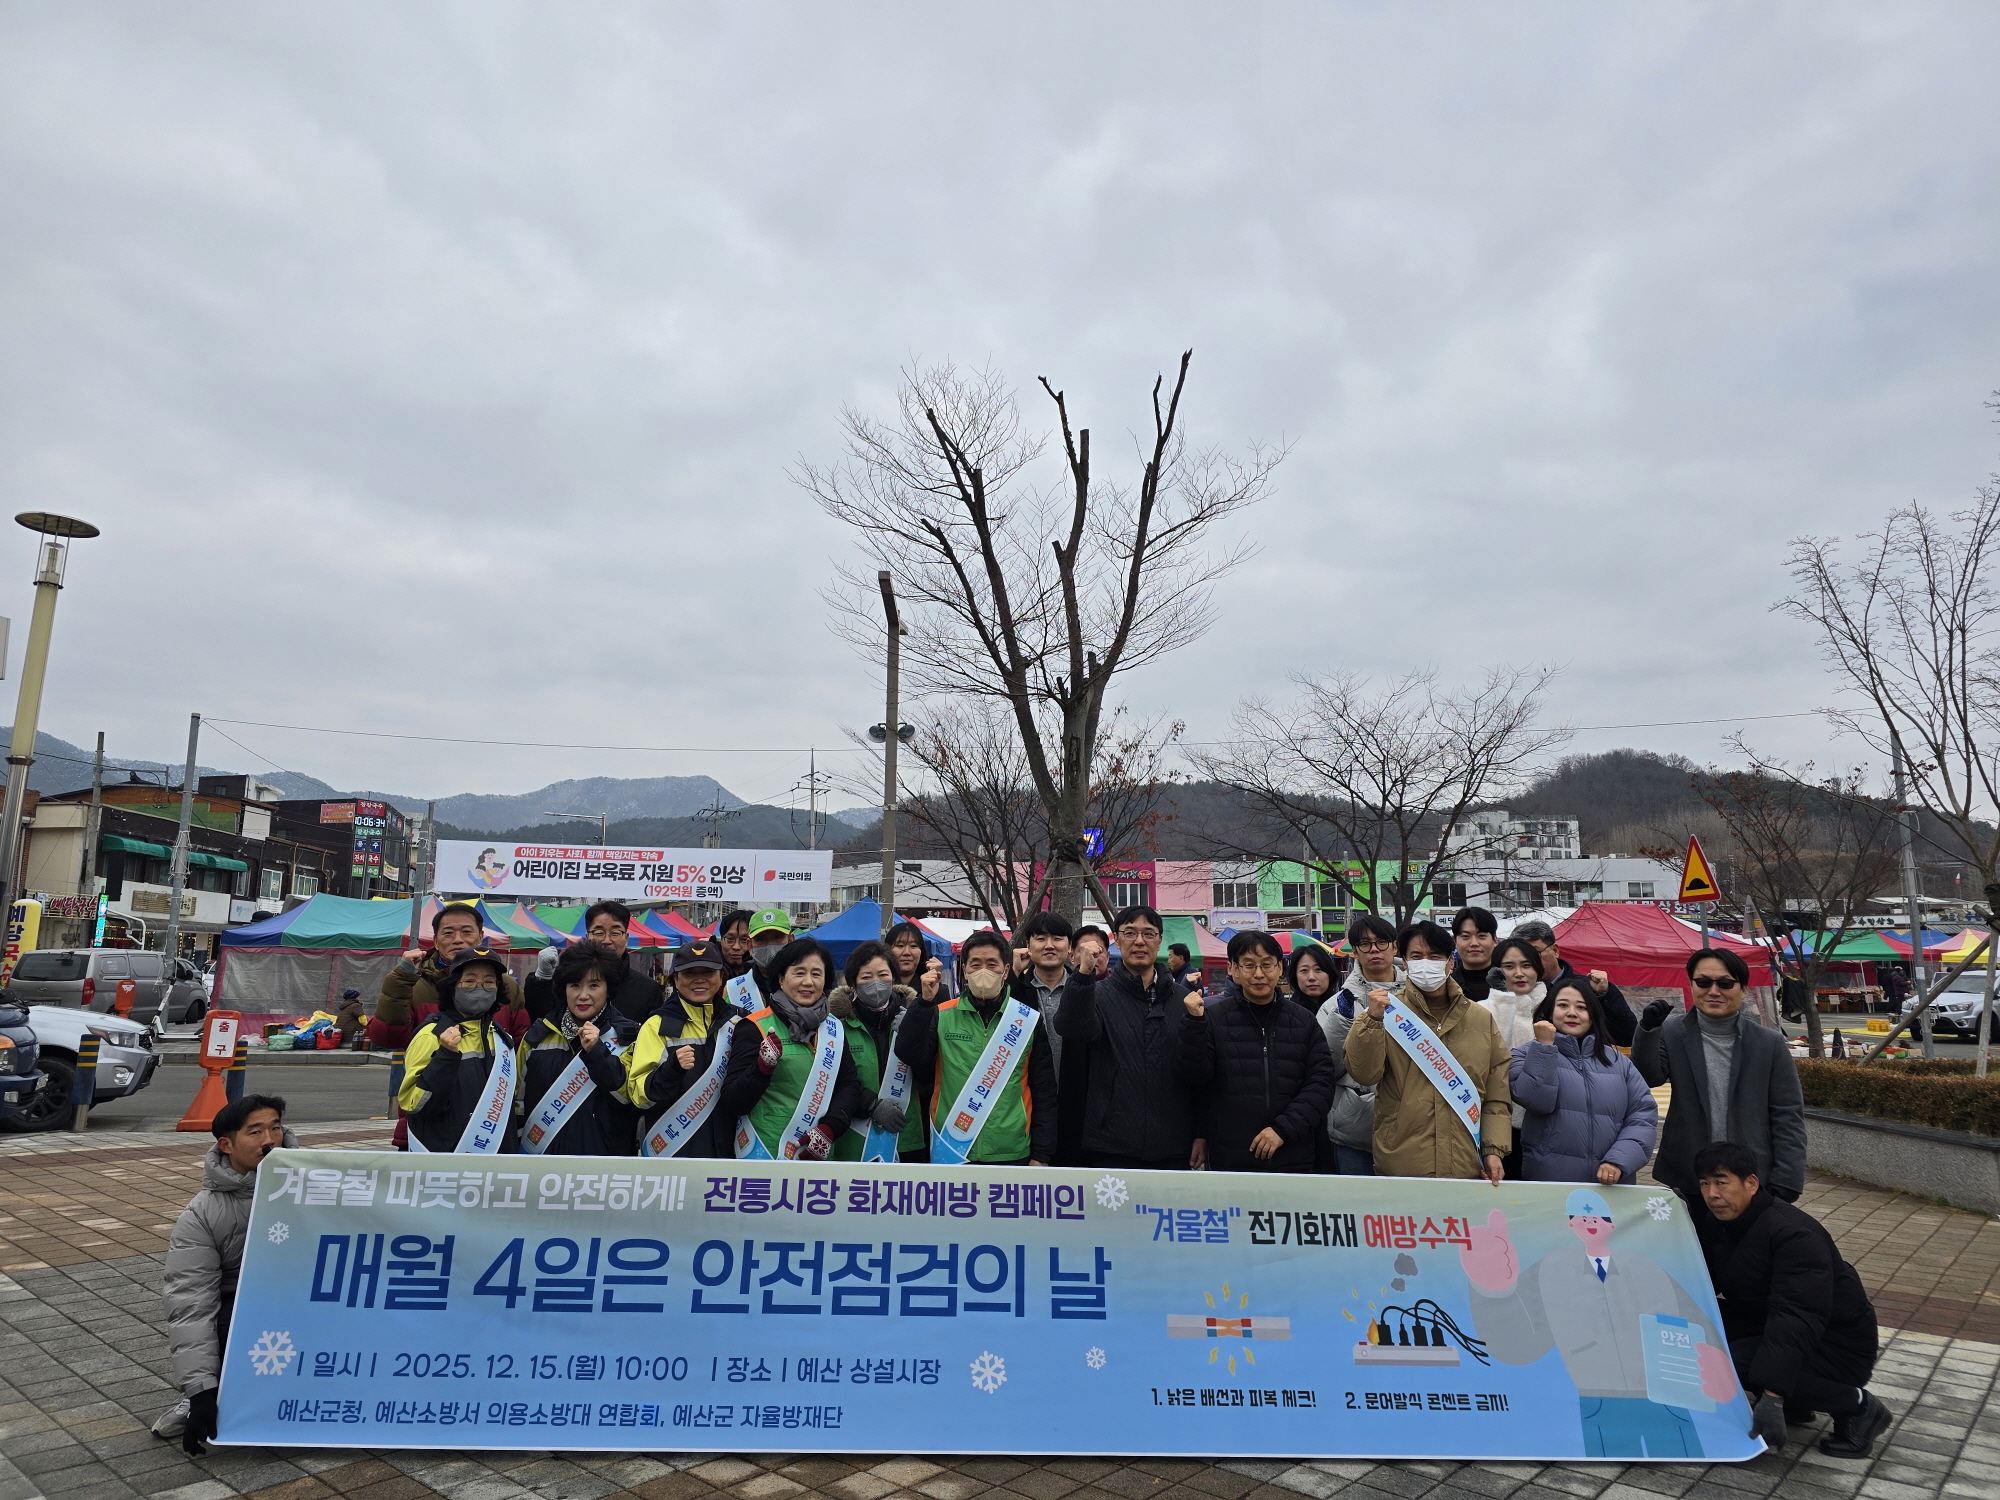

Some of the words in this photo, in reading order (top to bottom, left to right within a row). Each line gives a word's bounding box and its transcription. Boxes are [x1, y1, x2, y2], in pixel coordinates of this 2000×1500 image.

[354, 816, 386, 828] 10:06:34
[521, 848, 538, 857] 아이
[539, 848, 564, 858] 키우는
[566, 849, 585, 859] 사회,
[586, 850, 604, 859] 함께
[606, 851, 640, 860] 책임지는
[641, 852, 658, 861] 약속
[514, 860, 581, 880] 어린이집
[583, 862, 636, 881] 보육료
[638, 864, 674, 882] 지원
[676, 865, 706, 883] 5%
[710, 865, 746, 884] 인상
[778, 872, 812, 882] 국민의힘
[644, 885, 693, 898] (192억원
[696, 886, 724, 898] 증액)
[1004, 1018, 1023, 1047] 4일은
[822, 1040, 836, 1070] 4일은
[1394, 1013, 1422, 1042] 4일은
[1416, 1038, 1464, 1091] 안전점검의
[1456, 1088, 1472, 1104] 날
[974, 1045, 1012, 1100] 안전점검의
[802, 1070, 830, 1126] 안전점검의
[890, 1085, 904, 1098] 날
[480, 1076, 510, 1134] 안전점검의
[676, 1078, 719, 1130] 안전점검의
[968, 1097, 983, 1112] 날
[540, 1110, 556, 1127] 날
[474, 1134, 490, 1150] 날
[664, 1124, 680, 1140] 날
[268, 1167, 379, 1207] 겨울철
[385, 1170, 530, 1210] 따뜻하고
[538, 1173, 687, 1212] 안전하게!
[703, 1176, 840, 1215] 전통시장
[847, 1178, 979, 1218] 화재예방
[988, 1183, 1086, 1220] 캠페인
[1248, 1210, 1358, 1248] 전기화재
[1363, 1214, 1473, 1251] 예방수칙
[310, 1234, 456, 1311] 매월
[473, 1237, 670, 1314] 4일은
[690, 1239, 1026, 1318] 안전점검의
[1049, 1246, 1112, 1320] 날
[1660, 1330, 1691, 1350] 안전
[314, 1351, 360, 1378] 일시
[393, 1352, 476, 1379] 2025.
[486, 1354, 519, 1379] 12.
[615, 1356, 688, 1382] 10:00
[726, 1357, 772, 1384] 장소
[797, 1358, 842, 1384] 예산
[850, 1358, 942, 1385] 상설시장
[1151, 1388, 1164, 1406] 1.
[1200, 1389, 1244, 1407] 배선과
[1248, 1390, 1278, 1408] 피복
[1282, 1390, 1316, 1408] 체크!
[1346, 1392, 1361, 1410] 2.
[1366, 1392, 1422, 1410] 문어발식
[1428, 1393, 1471, 1410] 콘센트
[1476, 1394, 1509, 1412] 금지!
[277, 1399, 366, 1424] 예산군청,
[374, 1401, 480, 1425] 예산소방서
[486, 1402, 592, 1427] 의용소방대
[598, 1404, 665, 1428] 연합회,
[672, 1405, 734, 1428] 예산군
[740, 1405, 843, 1429] 자율방재단
